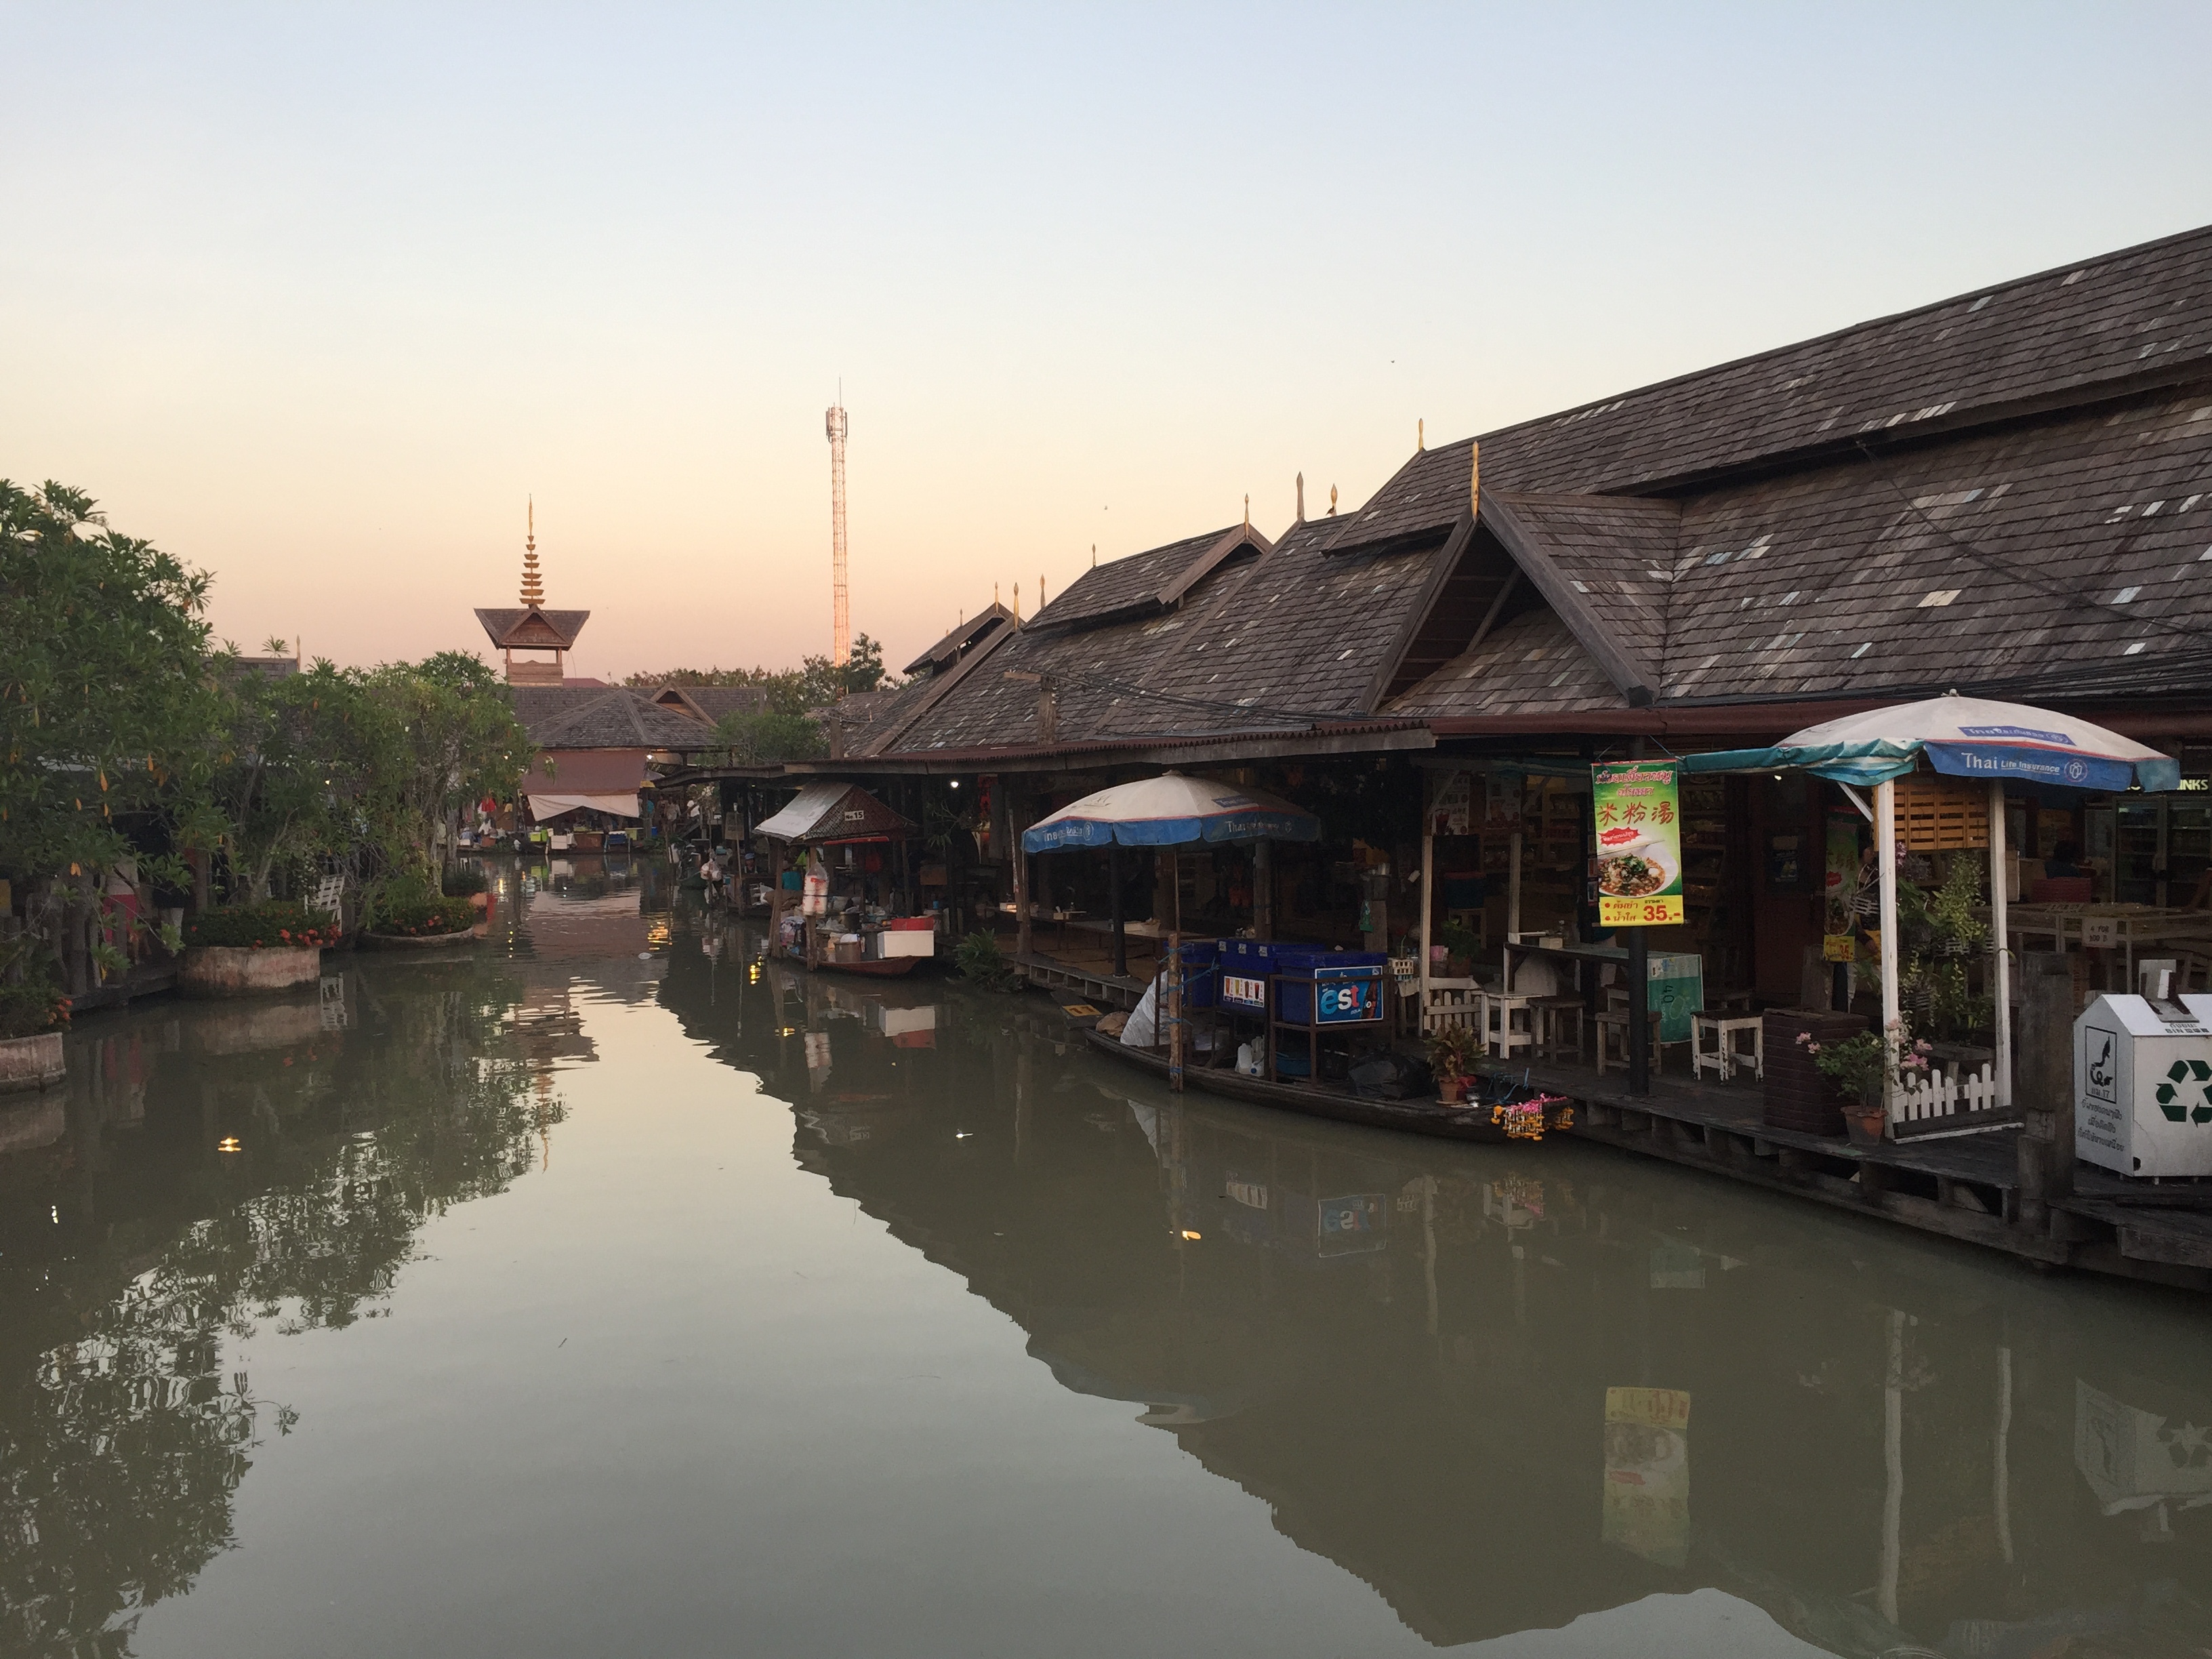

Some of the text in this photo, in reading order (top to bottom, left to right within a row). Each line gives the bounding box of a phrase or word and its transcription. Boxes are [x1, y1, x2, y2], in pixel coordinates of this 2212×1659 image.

[1961, 752, 2060, 773] Thai Life Insurance
[1321, 985, 1360, 1015] est
